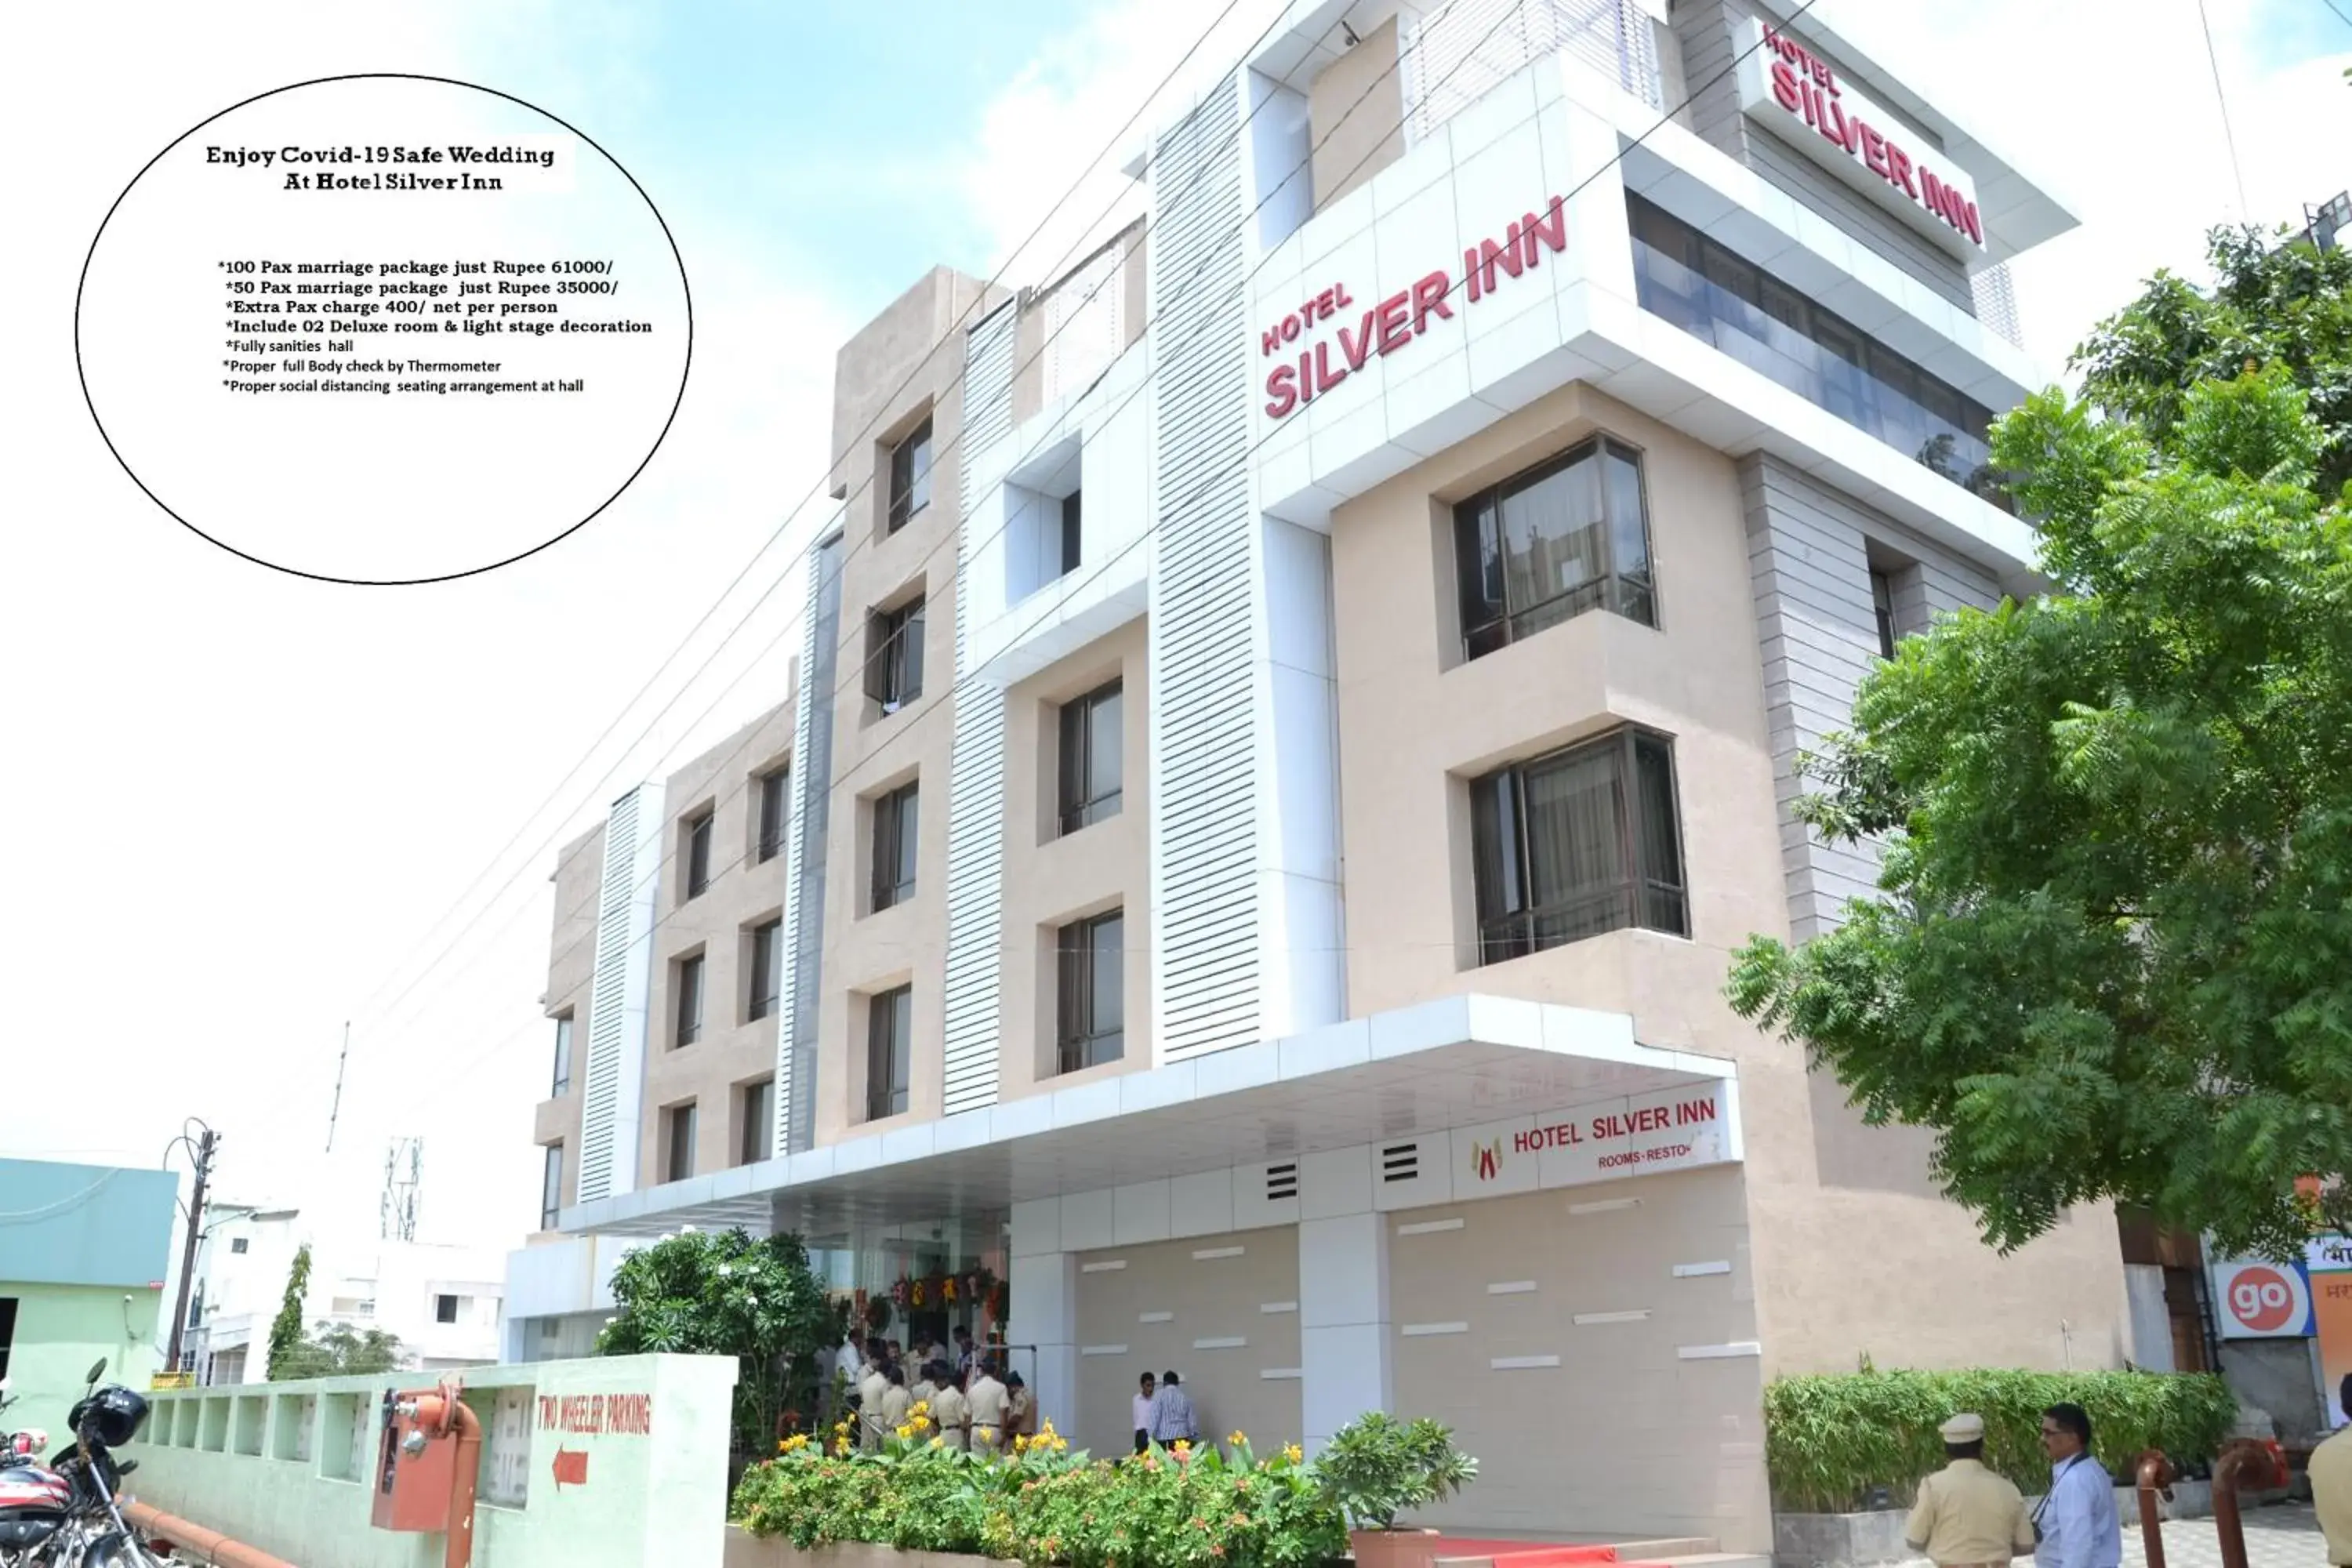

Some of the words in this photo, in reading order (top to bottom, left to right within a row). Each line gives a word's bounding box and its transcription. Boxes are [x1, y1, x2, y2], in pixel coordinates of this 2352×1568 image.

[1762, 23, 1841, 97] HOTEL
[1771, 60, 1918, 200] SILVER
[1918, 165, 1983, 246] INN
[1261, 281, 1354, 357] HOTEL
[1265, 269, 1455, 420] SILVER
[1464, 194, 1567, 303] INN
[1514, 1123, 1584, 1153] HOTEL
[1592, 1105, 1671, 1140] SILVER
[1675, 1098, 1716, 1127] INN
[2234, 1283, 2288, 1320] go
[538, 1395, 557, 1431] TWO
[560, 1395, 603, 1434] WHEELER
[605, 1392, 652, 1436] PARKING
